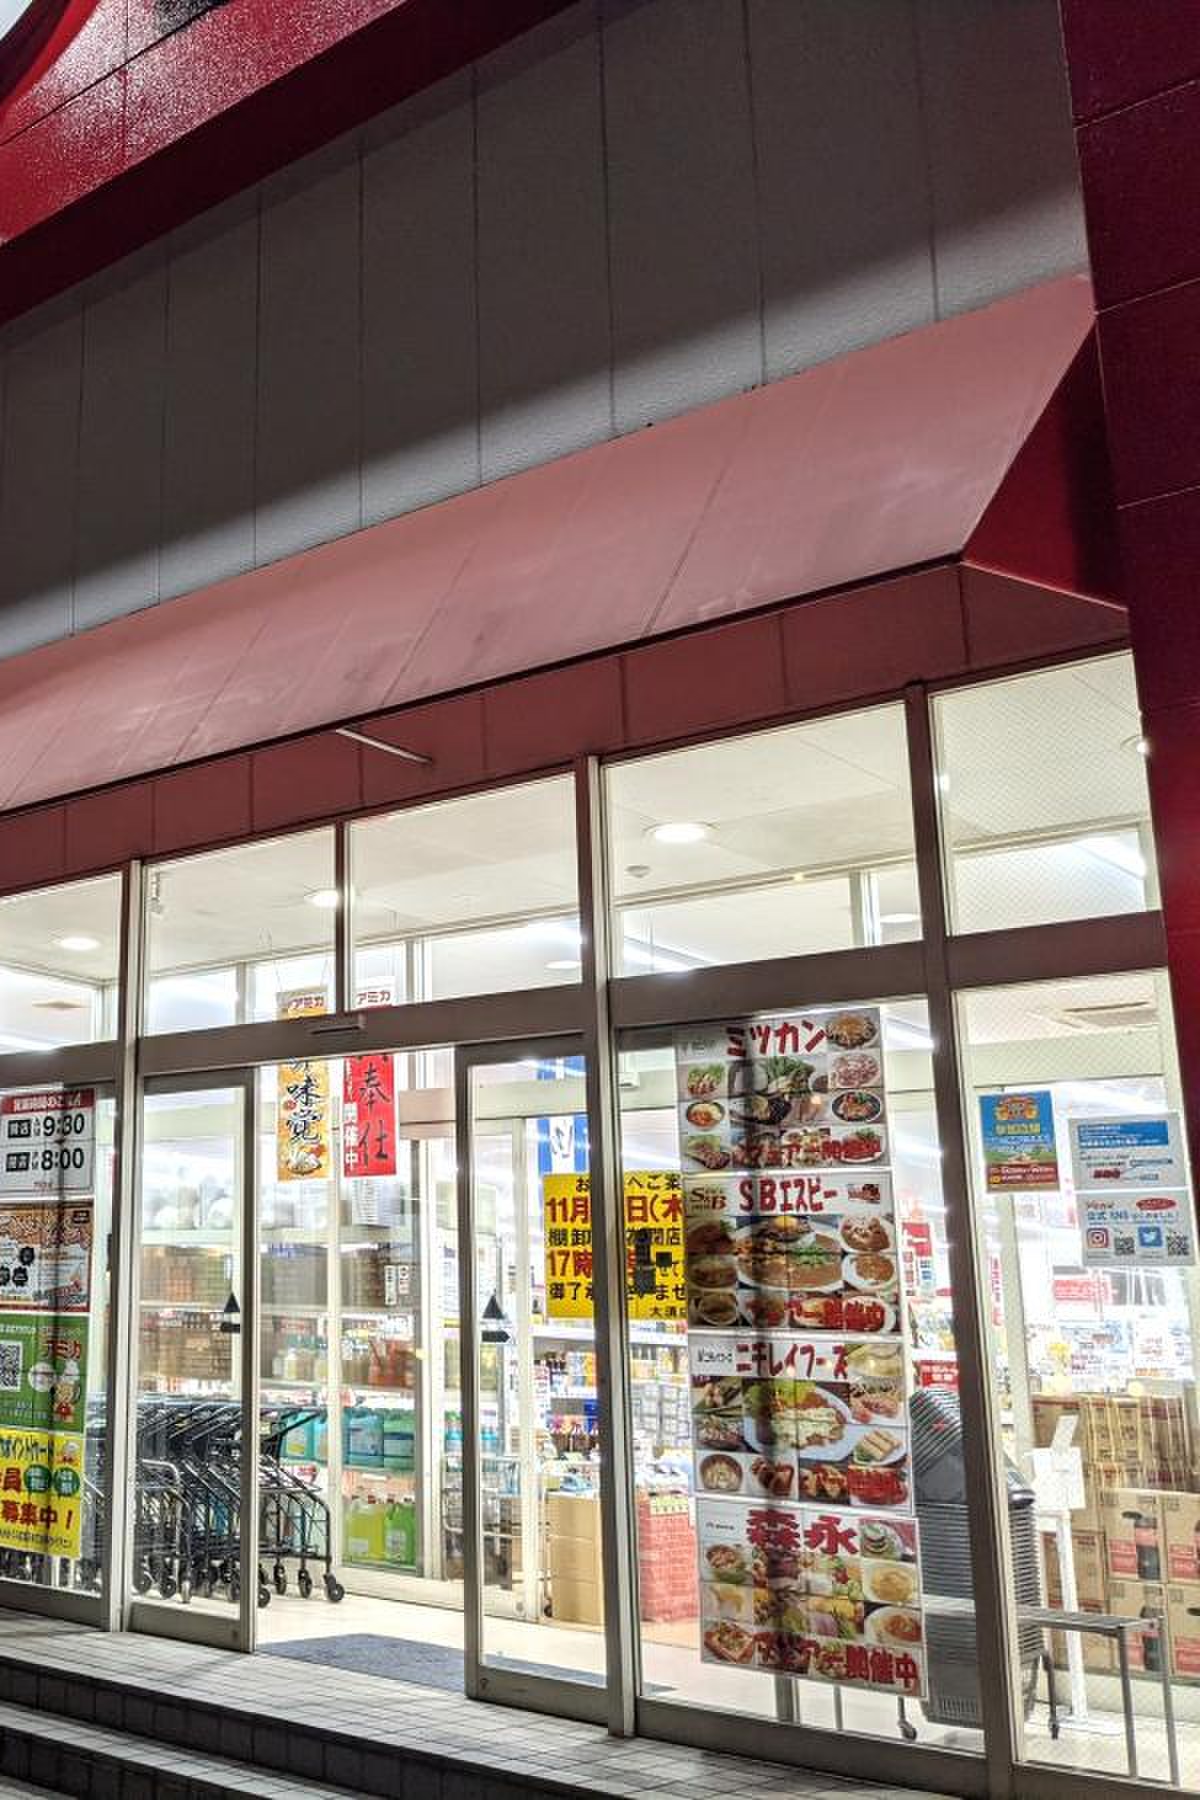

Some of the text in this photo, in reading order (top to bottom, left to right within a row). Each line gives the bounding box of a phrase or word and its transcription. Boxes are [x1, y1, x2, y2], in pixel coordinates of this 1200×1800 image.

[358, 991, 391, 1006] アミカ
[726, 1021, 825, 1056] ミツカン
[43, 1113, 85, 1136] 9:30
[41, 1147, 84, 1170] 8:00
[739, 1176, 838, 1213] SBエスビー
[746, 1509, 859, 1555] 森永
